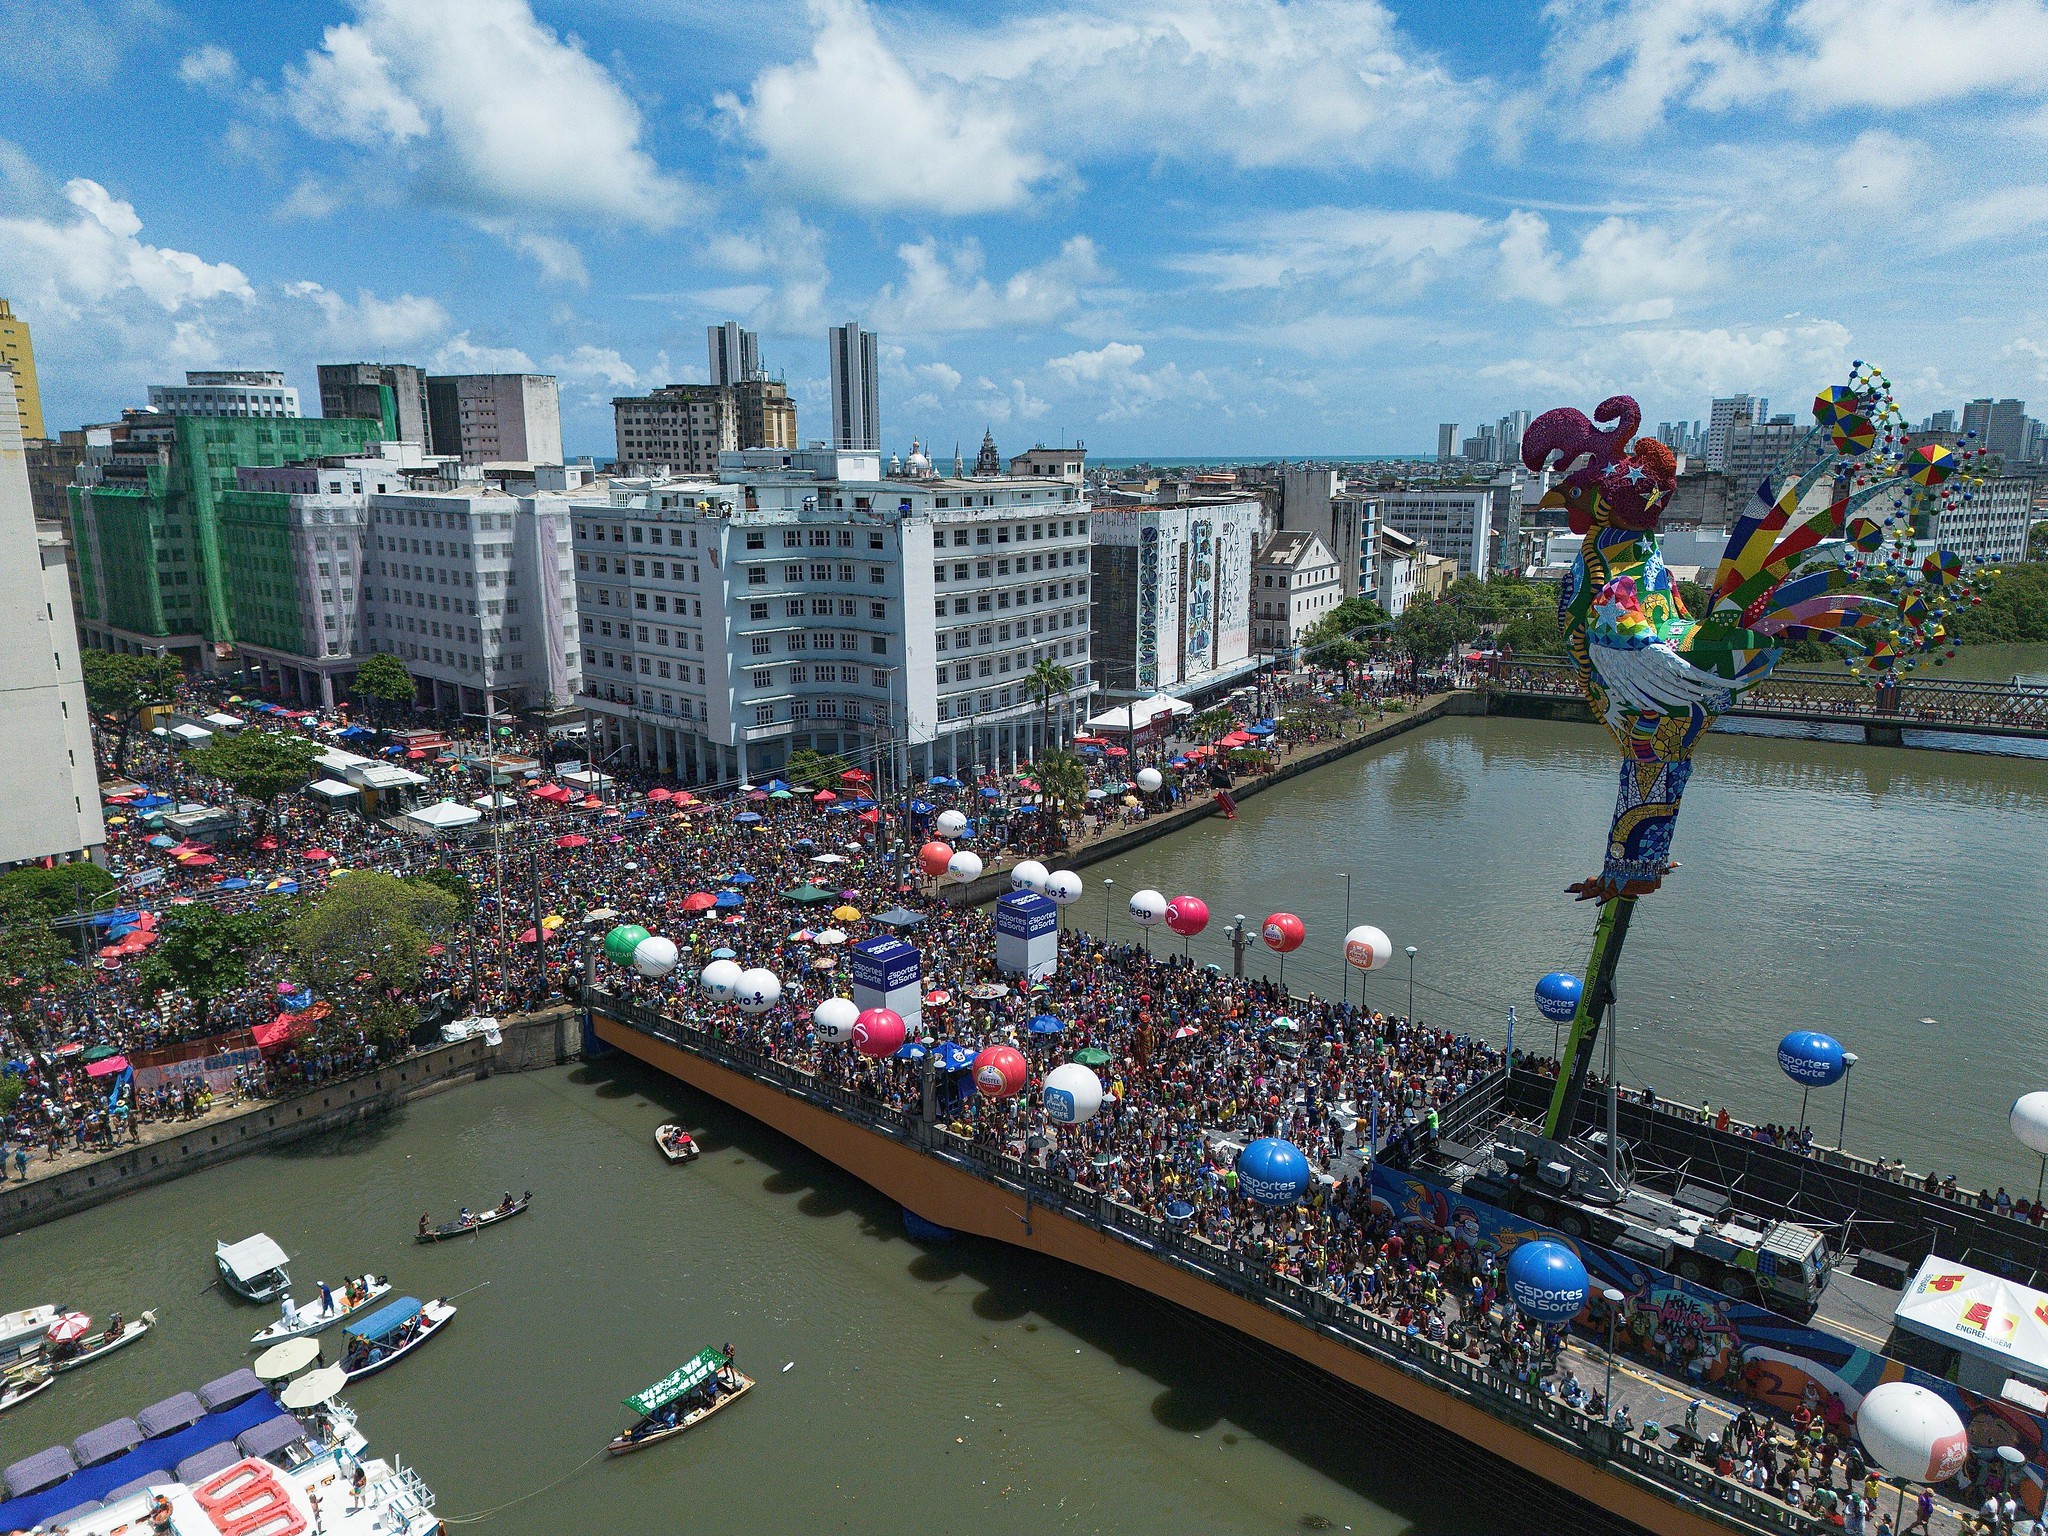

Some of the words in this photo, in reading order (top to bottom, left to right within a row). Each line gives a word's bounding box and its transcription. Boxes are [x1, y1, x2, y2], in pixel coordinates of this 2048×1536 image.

[998, 911, 1027, 926] Esportes
[1028, 910, 1057, 925] Esportes
[853, 961, 883, 977] Esportes
[887, 963, 919, 981] Esportes
[1778, 1050, 1831, 1070] Esportes
[979, 1075, 1001, 1085] AMSTEL
[1240, 1170, 1296, 1191] Esportes
[1514, 1280, 1583, 1301] Esportes
[1955, 1323, 2013, 1349] ENGREAGEM
